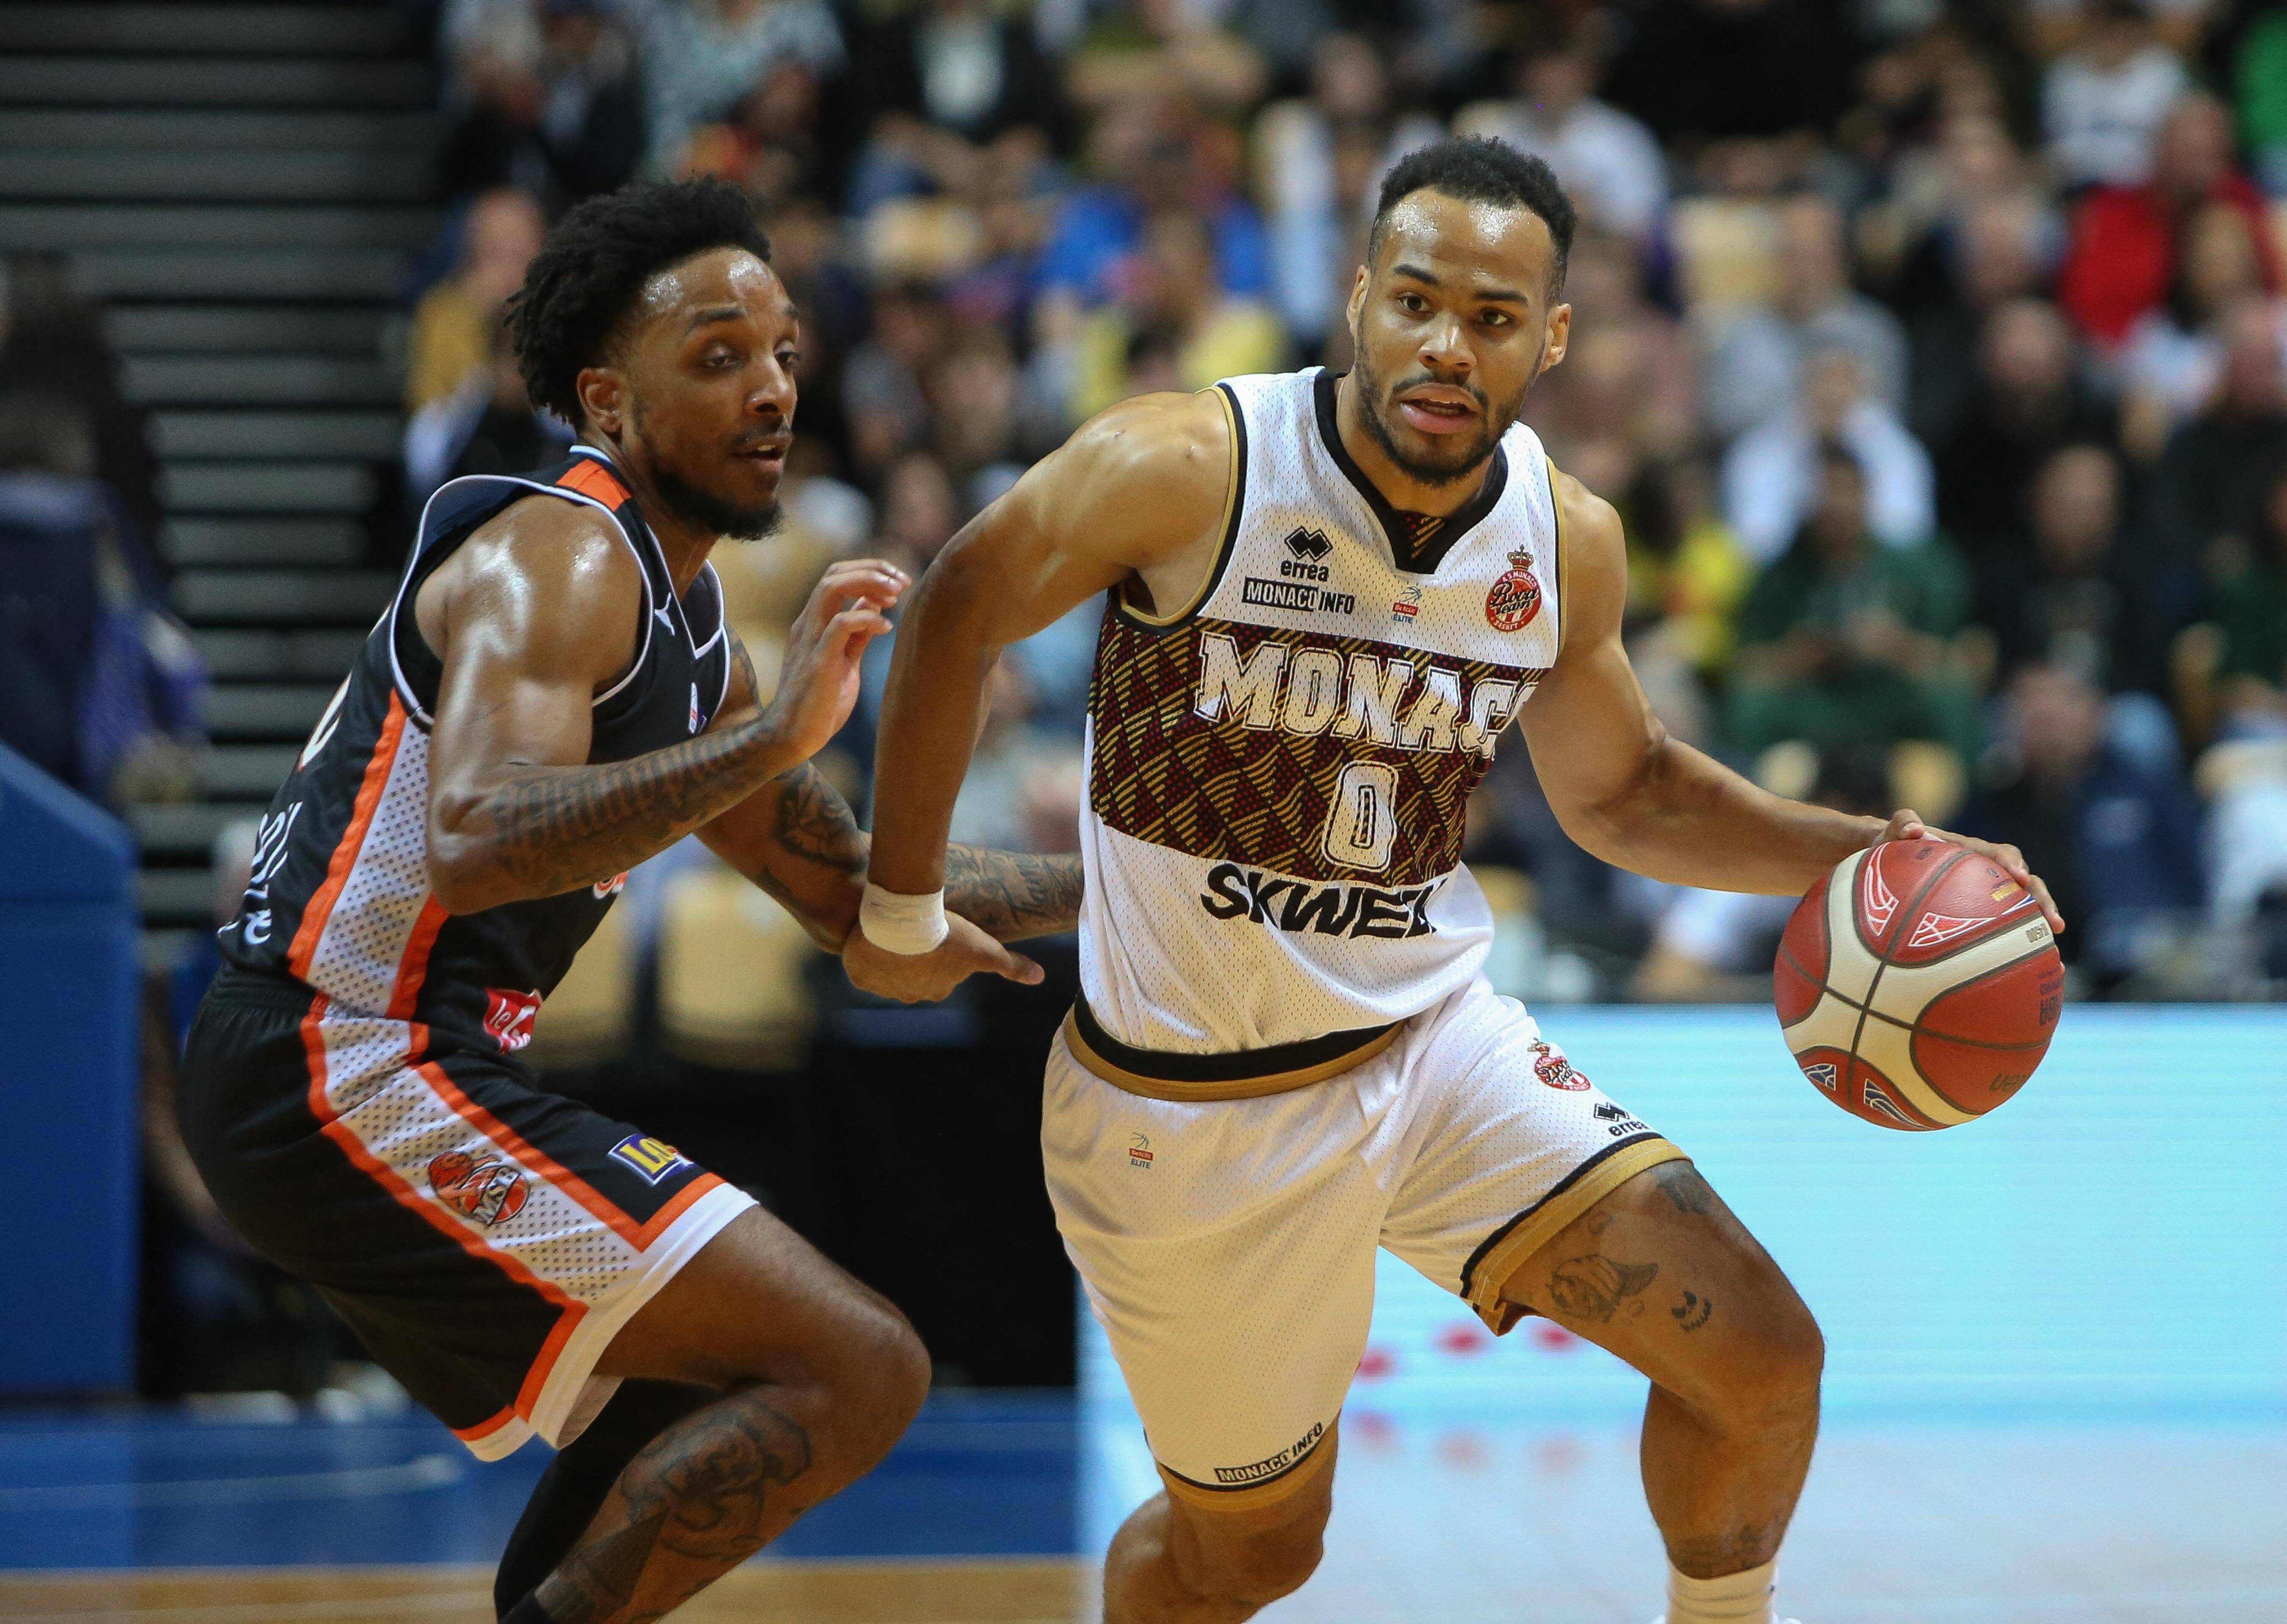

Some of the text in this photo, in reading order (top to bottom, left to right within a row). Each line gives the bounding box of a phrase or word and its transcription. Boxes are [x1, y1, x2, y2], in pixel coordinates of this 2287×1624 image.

[1280, 560, 1329, 582] errea
[1245, 579, 1355, 614] MONACO INFO
[1321, 760, 1399, 872] 0
[1217, 1421, 1323, 1482] MONACO INFO
